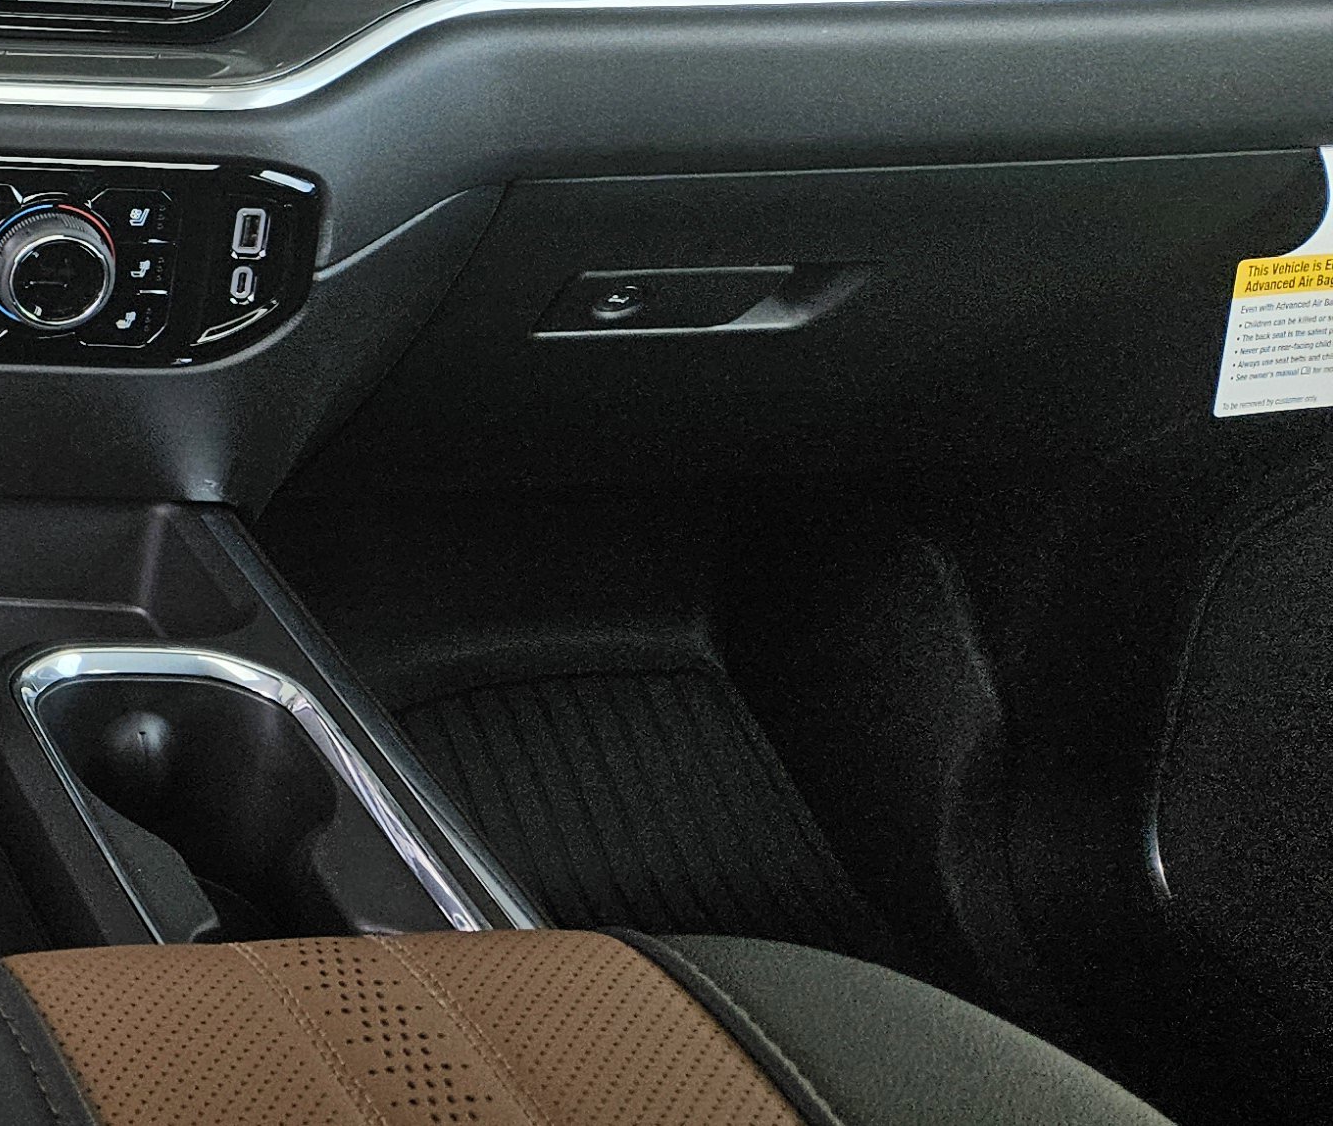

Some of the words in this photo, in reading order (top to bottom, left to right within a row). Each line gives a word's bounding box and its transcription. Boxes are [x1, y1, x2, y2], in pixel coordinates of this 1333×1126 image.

[1248, 264, 1269, 277] This
[1273, 261, 1310, 275] Vehicle
[1313, 259, 1322, 271] is
[1244, 277, 1296, 292] Advanced
[1298, 276, 1313, 288] Air
[1240, 305, 1257, 314] Even
[1276, 300, 1310, 310] Advanced
[1244, 320, 1271, 329] Children
[1288, 317, 1296, 325] be
[1298, 315, 1317, 324] killed
[1242, 334, 1253, 342] The
[1272, 331, 1286, 339] seat
